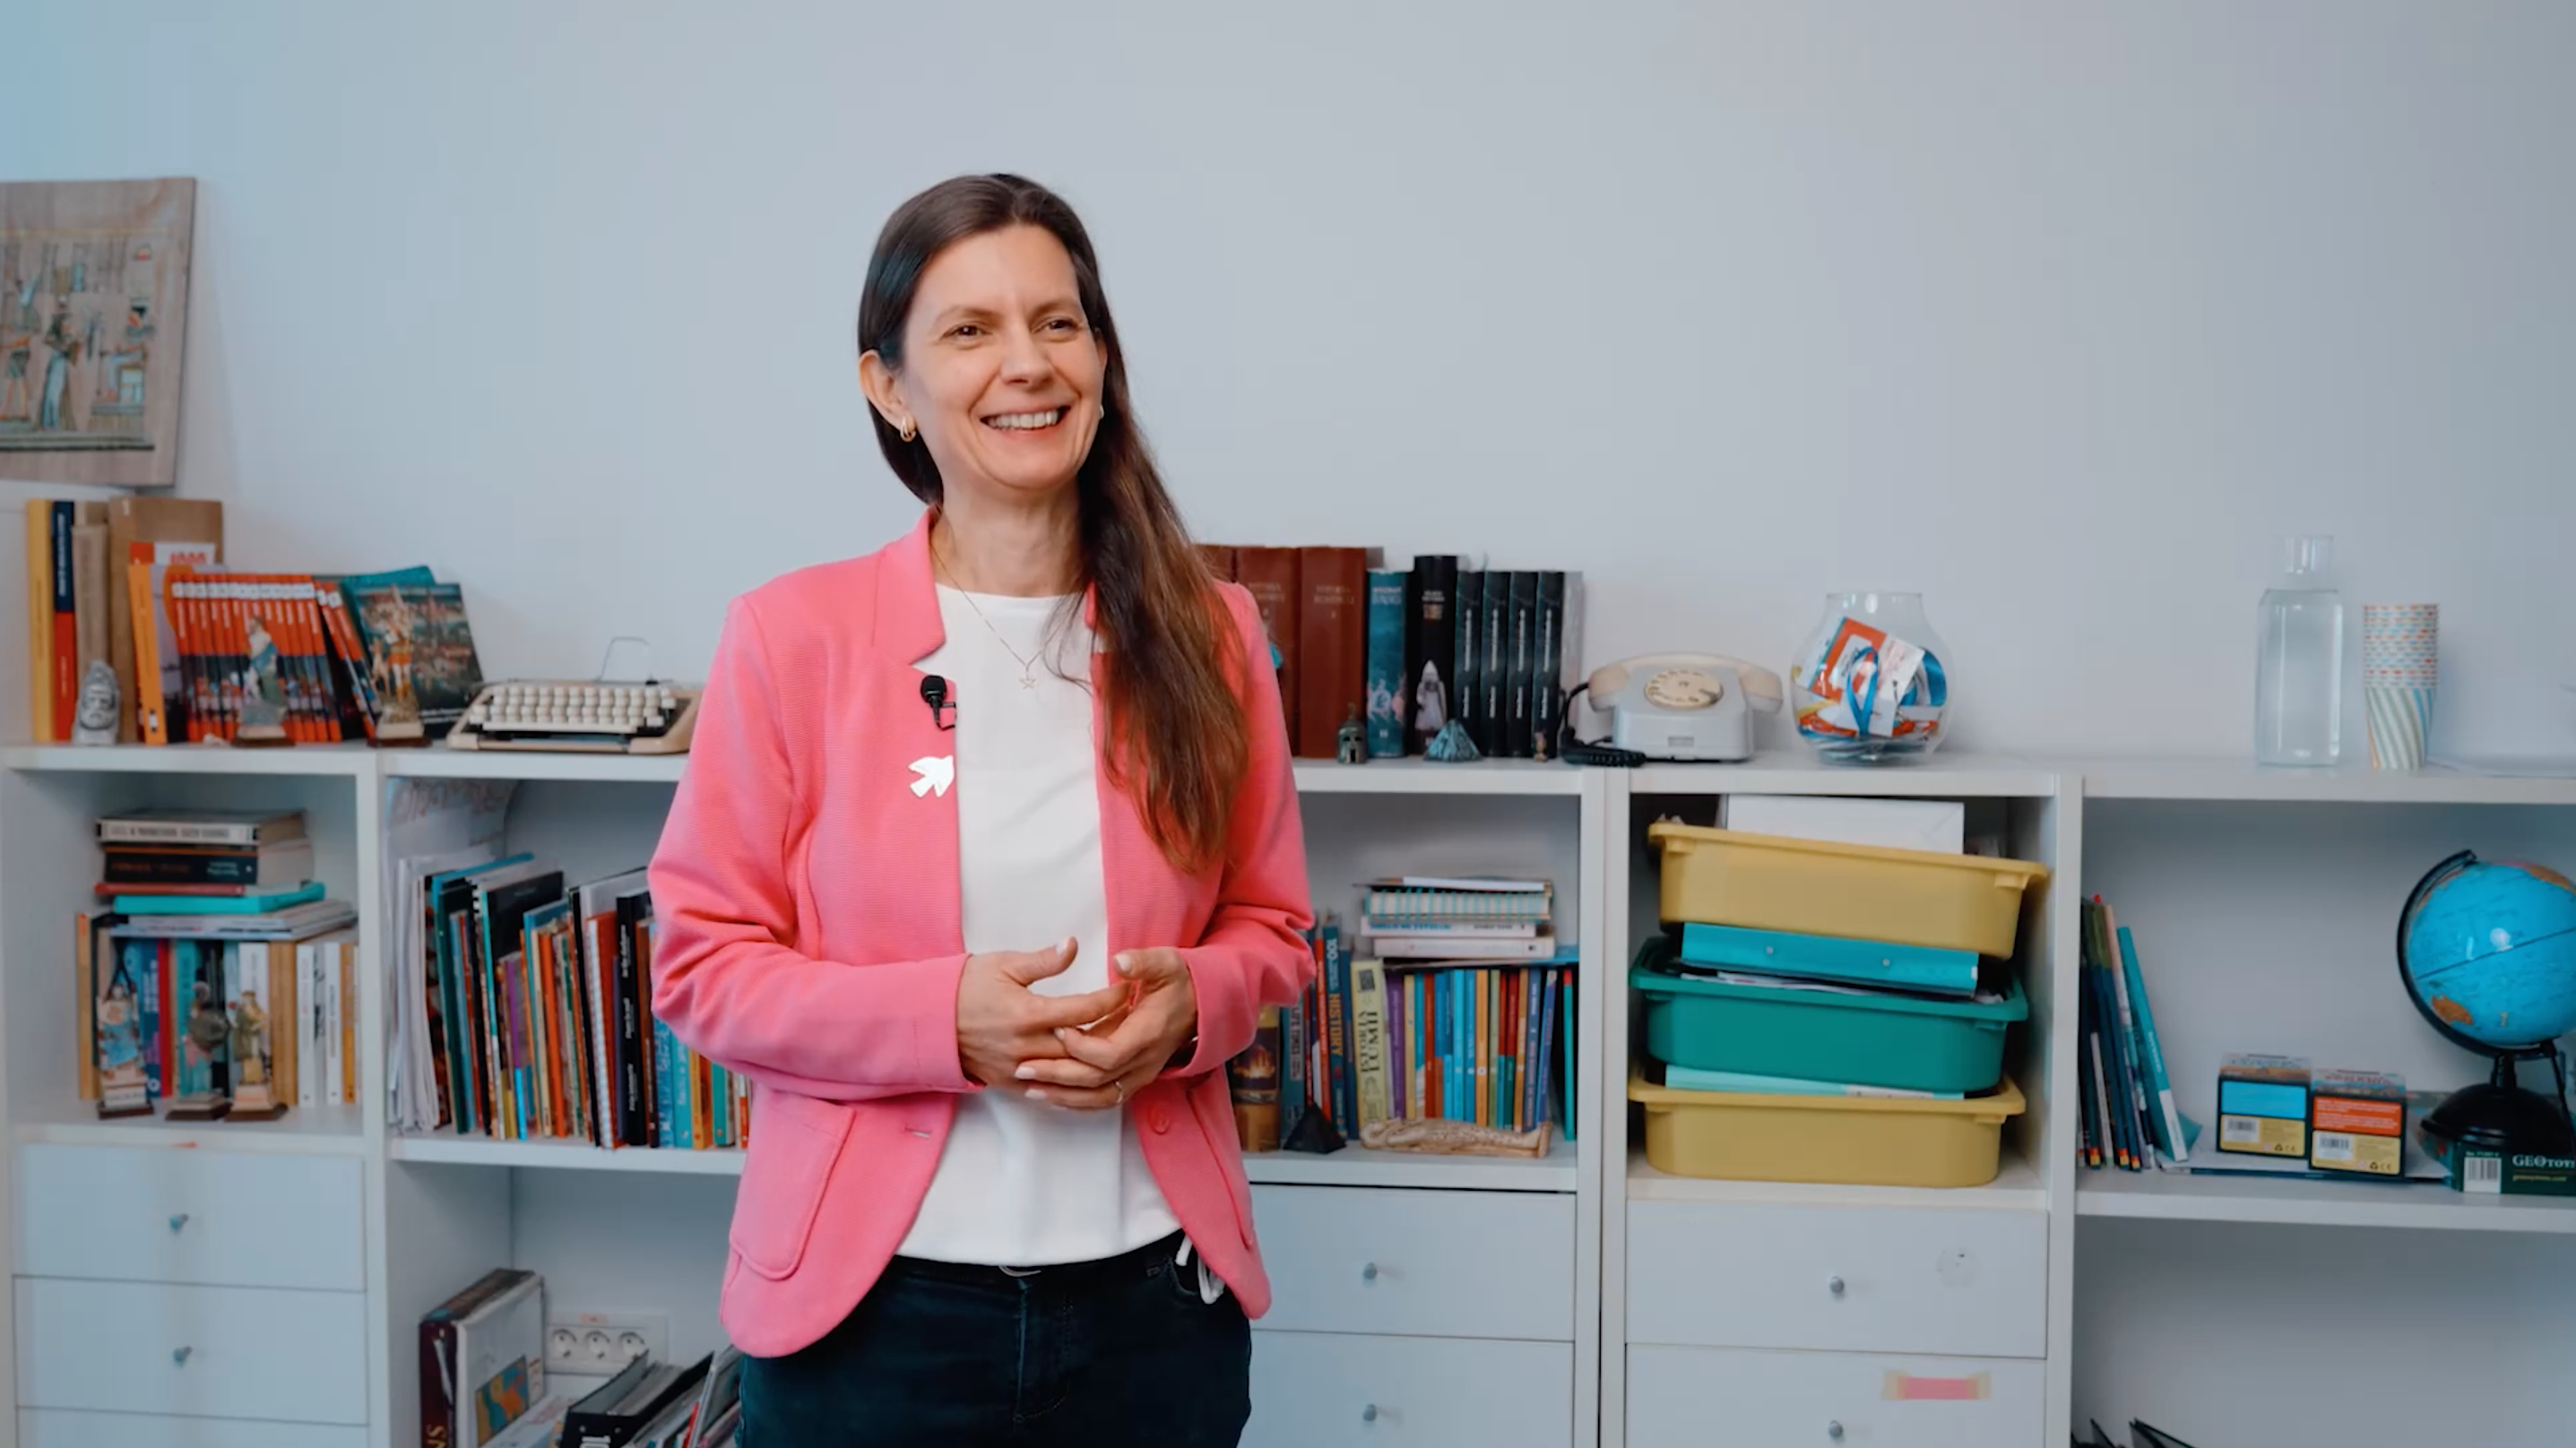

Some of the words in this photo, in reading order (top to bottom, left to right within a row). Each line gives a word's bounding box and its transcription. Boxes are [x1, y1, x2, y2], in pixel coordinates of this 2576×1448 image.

[1327, 938, 1339, 960] 100
[1328, 993, 1343, 1056] HISTORY
[1358, 1010, 1370, 1073] ISTORIA
[1367, 1011, 1380, 1073] LUMII
